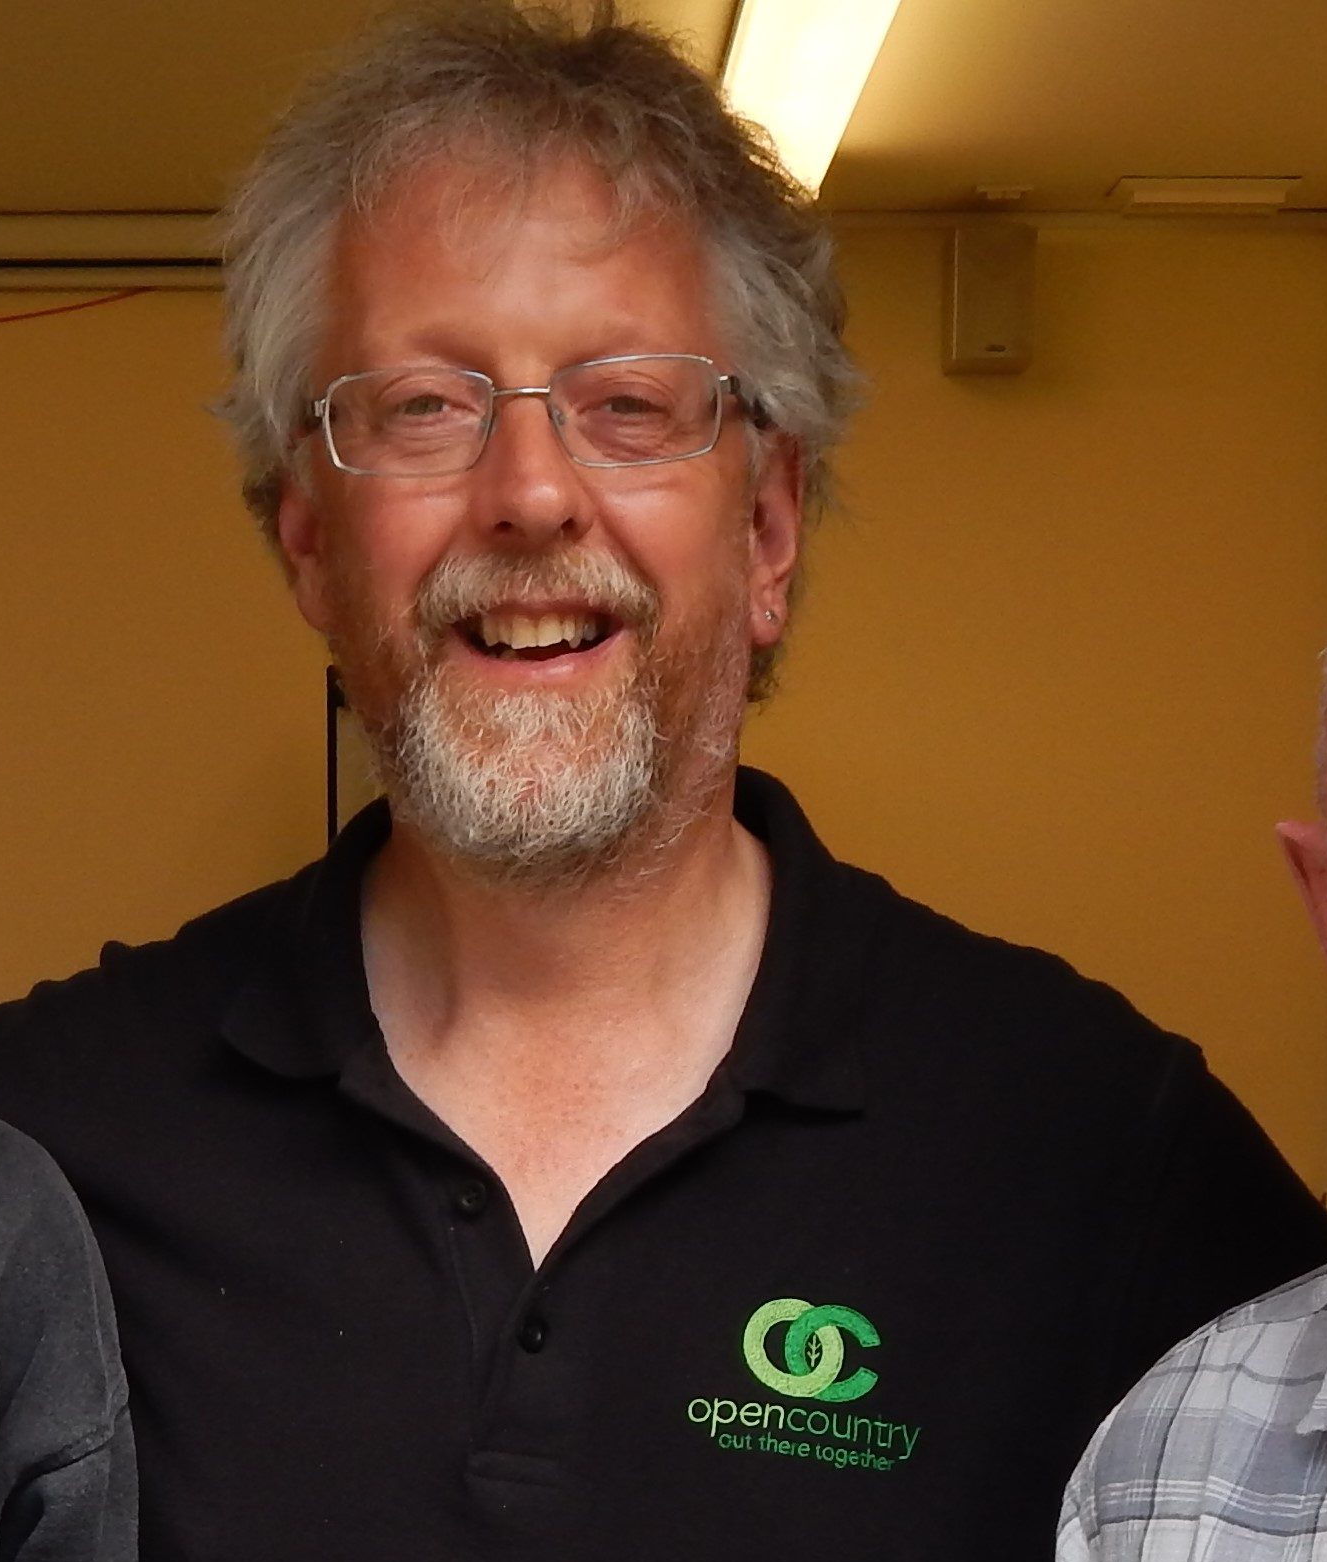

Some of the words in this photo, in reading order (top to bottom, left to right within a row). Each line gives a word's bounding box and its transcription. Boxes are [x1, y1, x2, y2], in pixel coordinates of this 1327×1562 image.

[687, 1398, 921, 1459] opencountry
[718, 1432, 753, 1450] out
[759, 1432, 810, 1457] there
[815, 1445, 895, 1470] together
